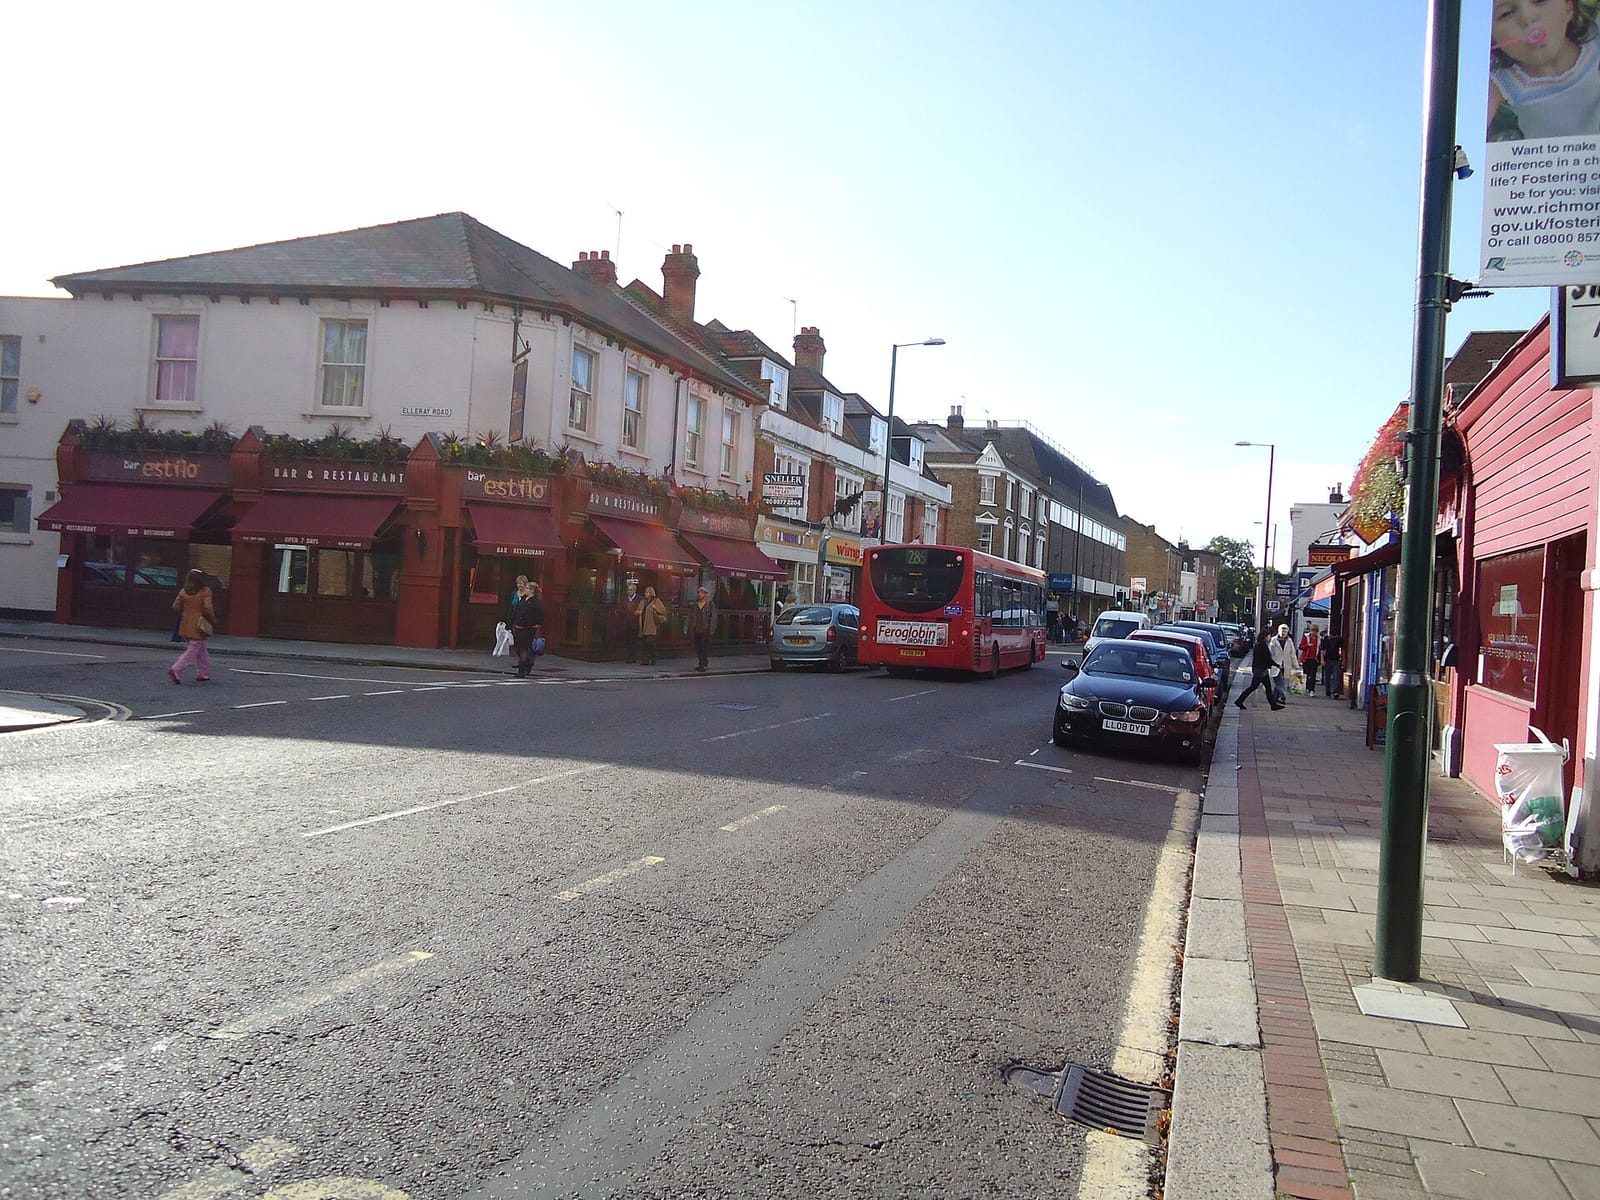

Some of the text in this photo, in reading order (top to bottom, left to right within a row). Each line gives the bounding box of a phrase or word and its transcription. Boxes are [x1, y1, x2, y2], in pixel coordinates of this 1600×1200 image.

[1511, 141, 1596, 156] Want to make
[1491, 161, 1553, 172] difference
[1556, 157, 1568, 167] in
[1490, 176, 1518, 187] life?
[1521, 172, 1587, 184] Fostering
[1509, 190, 1526, 200] be
[1529, 189, 1546, 198] for
[1549, 188, 1576, 199] you:
[1488, 232, 1600, 247] Or call 08000 857
[402, 407, 449, 416] ELLERAY ROAD
[123, 459, 198, 479] bar estilo
[274, 467, 405, 483] BAR & RESTAURANT
[467, 470, 545, 499] bar estilo
[764, 474, 802, 484] SNELLER
[614, 497, 658, 515] RESTAURANT
[306, 537, 319, 545] DAYS
[513, 547, 545, 556] RESTAURANT
[1311, 555, 1348, 563] NICOLAS
[878, 625, 936, 641] Feroglobin
[1105, 720, 1146, 733] LL08 DYD
